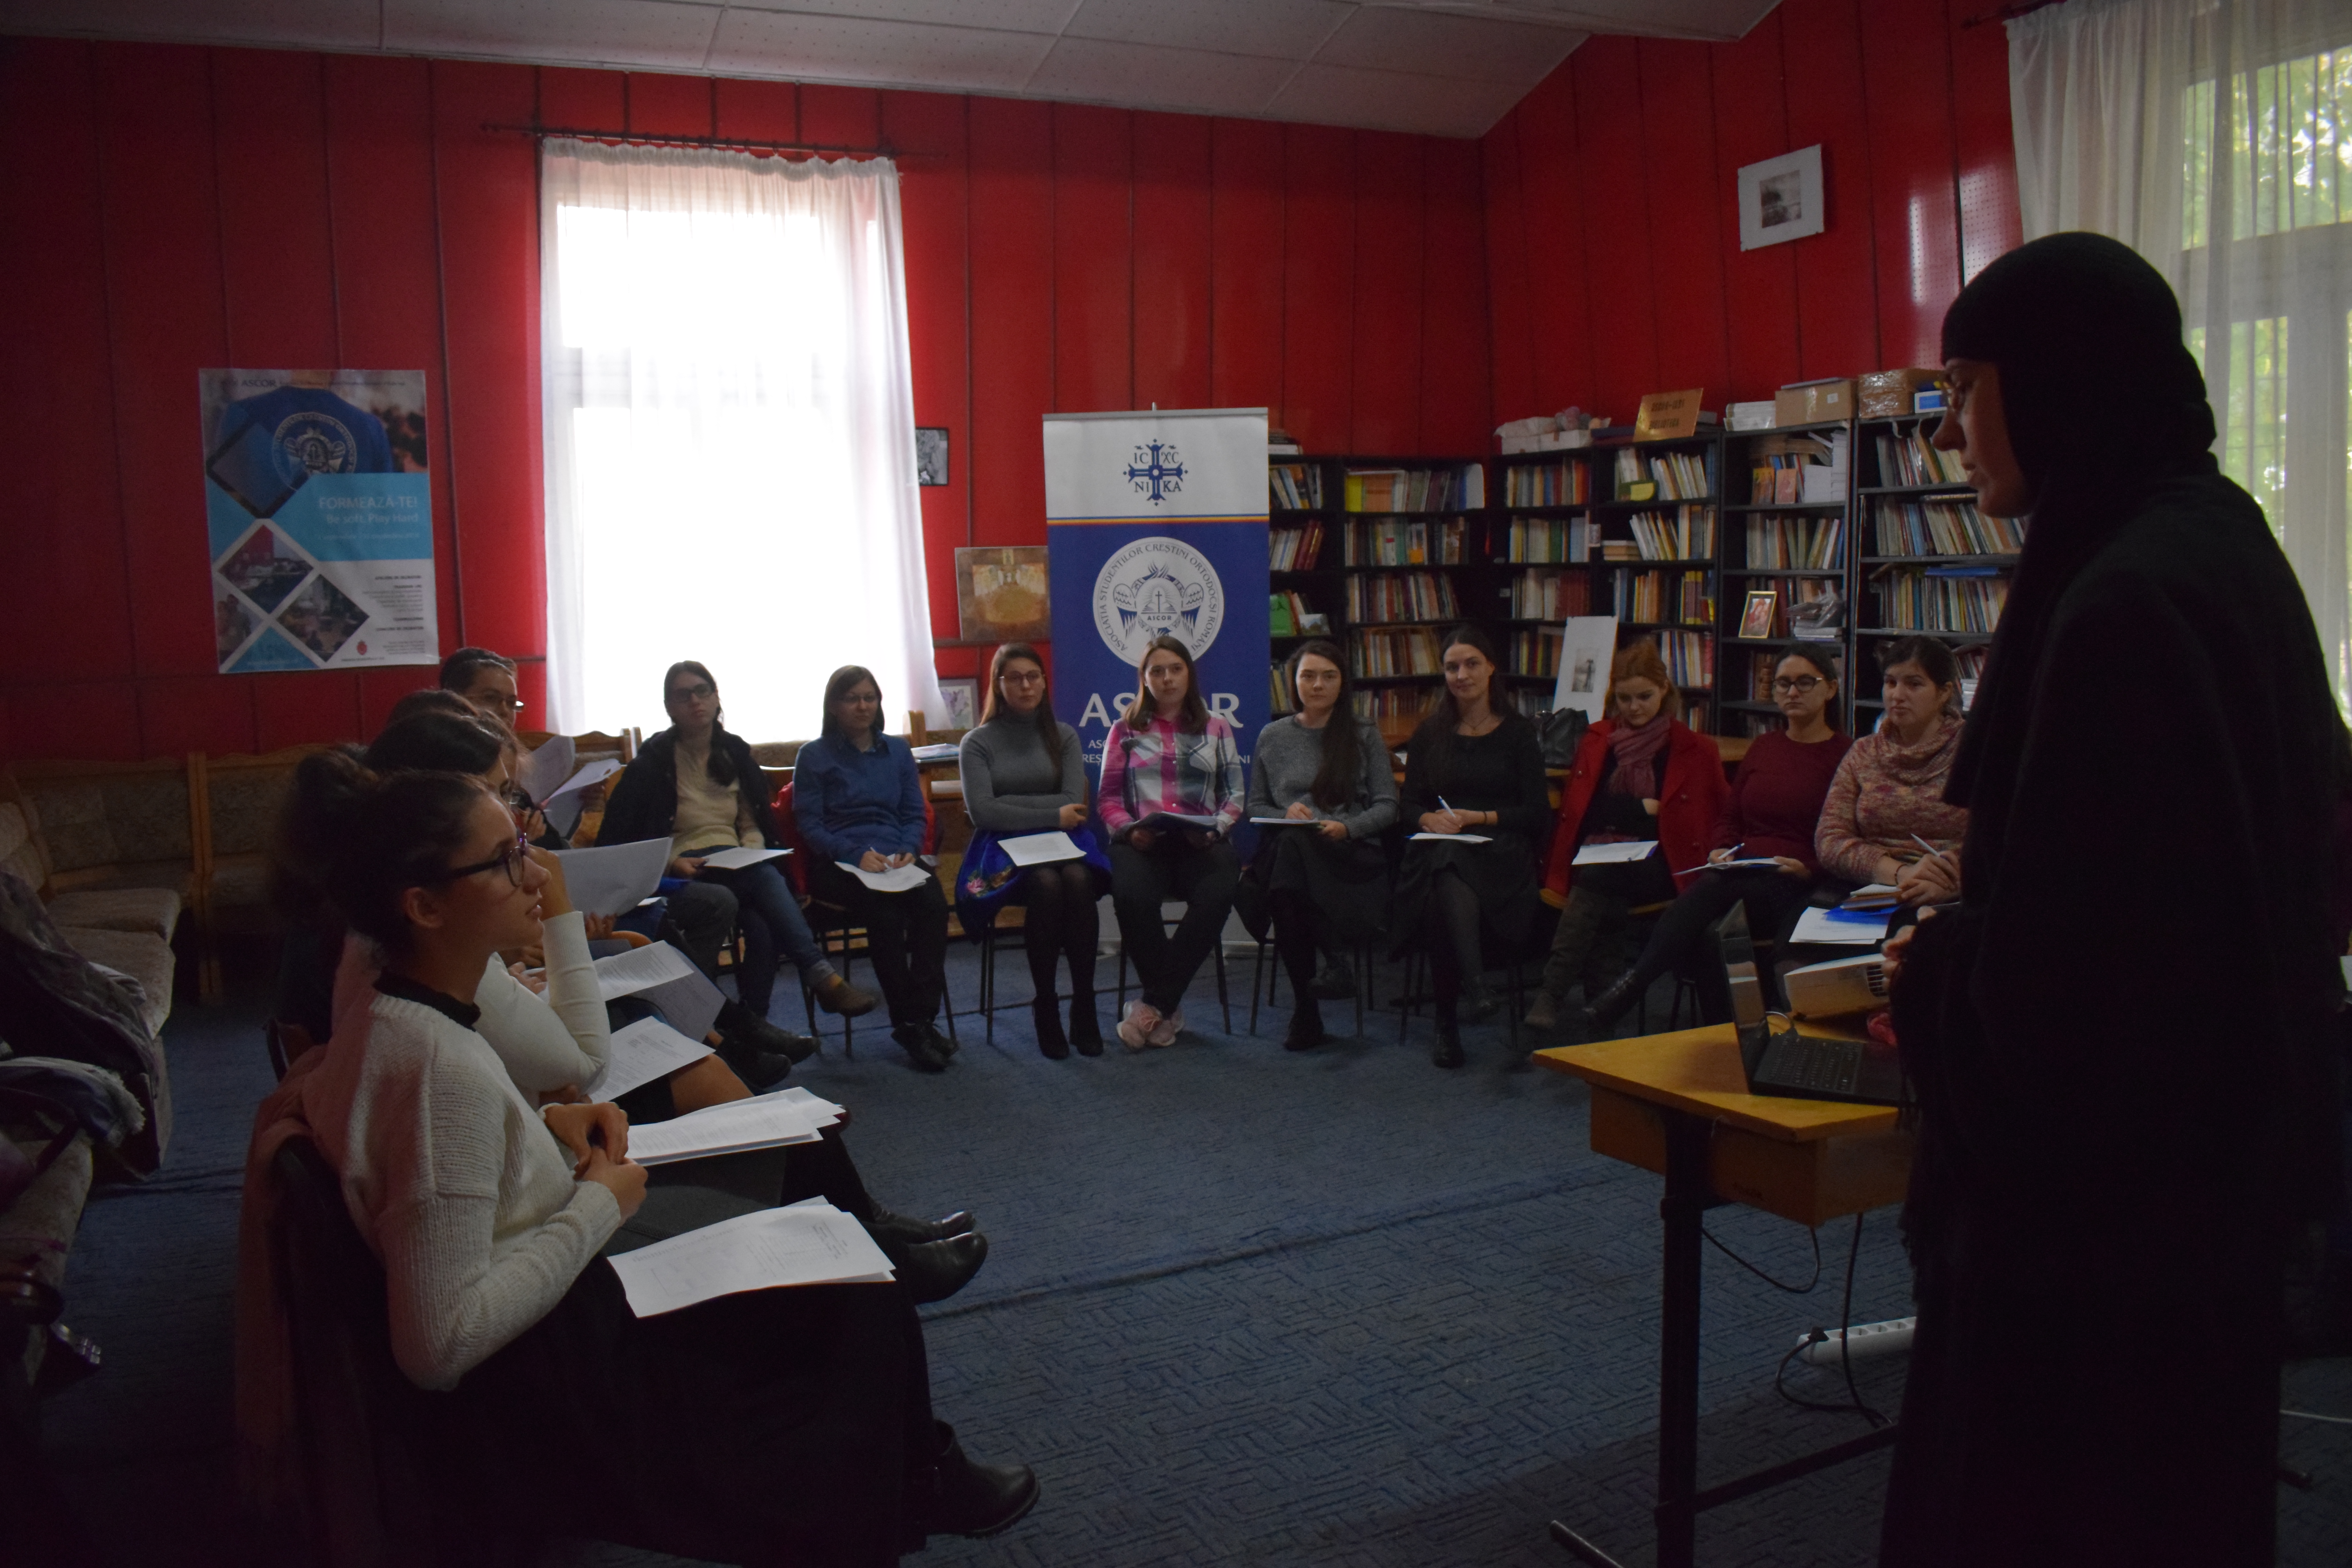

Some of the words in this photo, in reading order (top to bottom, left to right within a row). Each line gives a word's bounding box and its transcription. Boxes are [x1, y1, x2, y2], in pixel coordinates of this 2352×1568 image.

[241, 379, 276, 387] ASCOR
[368, 514, 390, 524] Play
[393, 512, 418, 522] Hard
[1145, 543, 1189, 559] CREȘTINI
[1079, 692, 1244, 728] ASR
